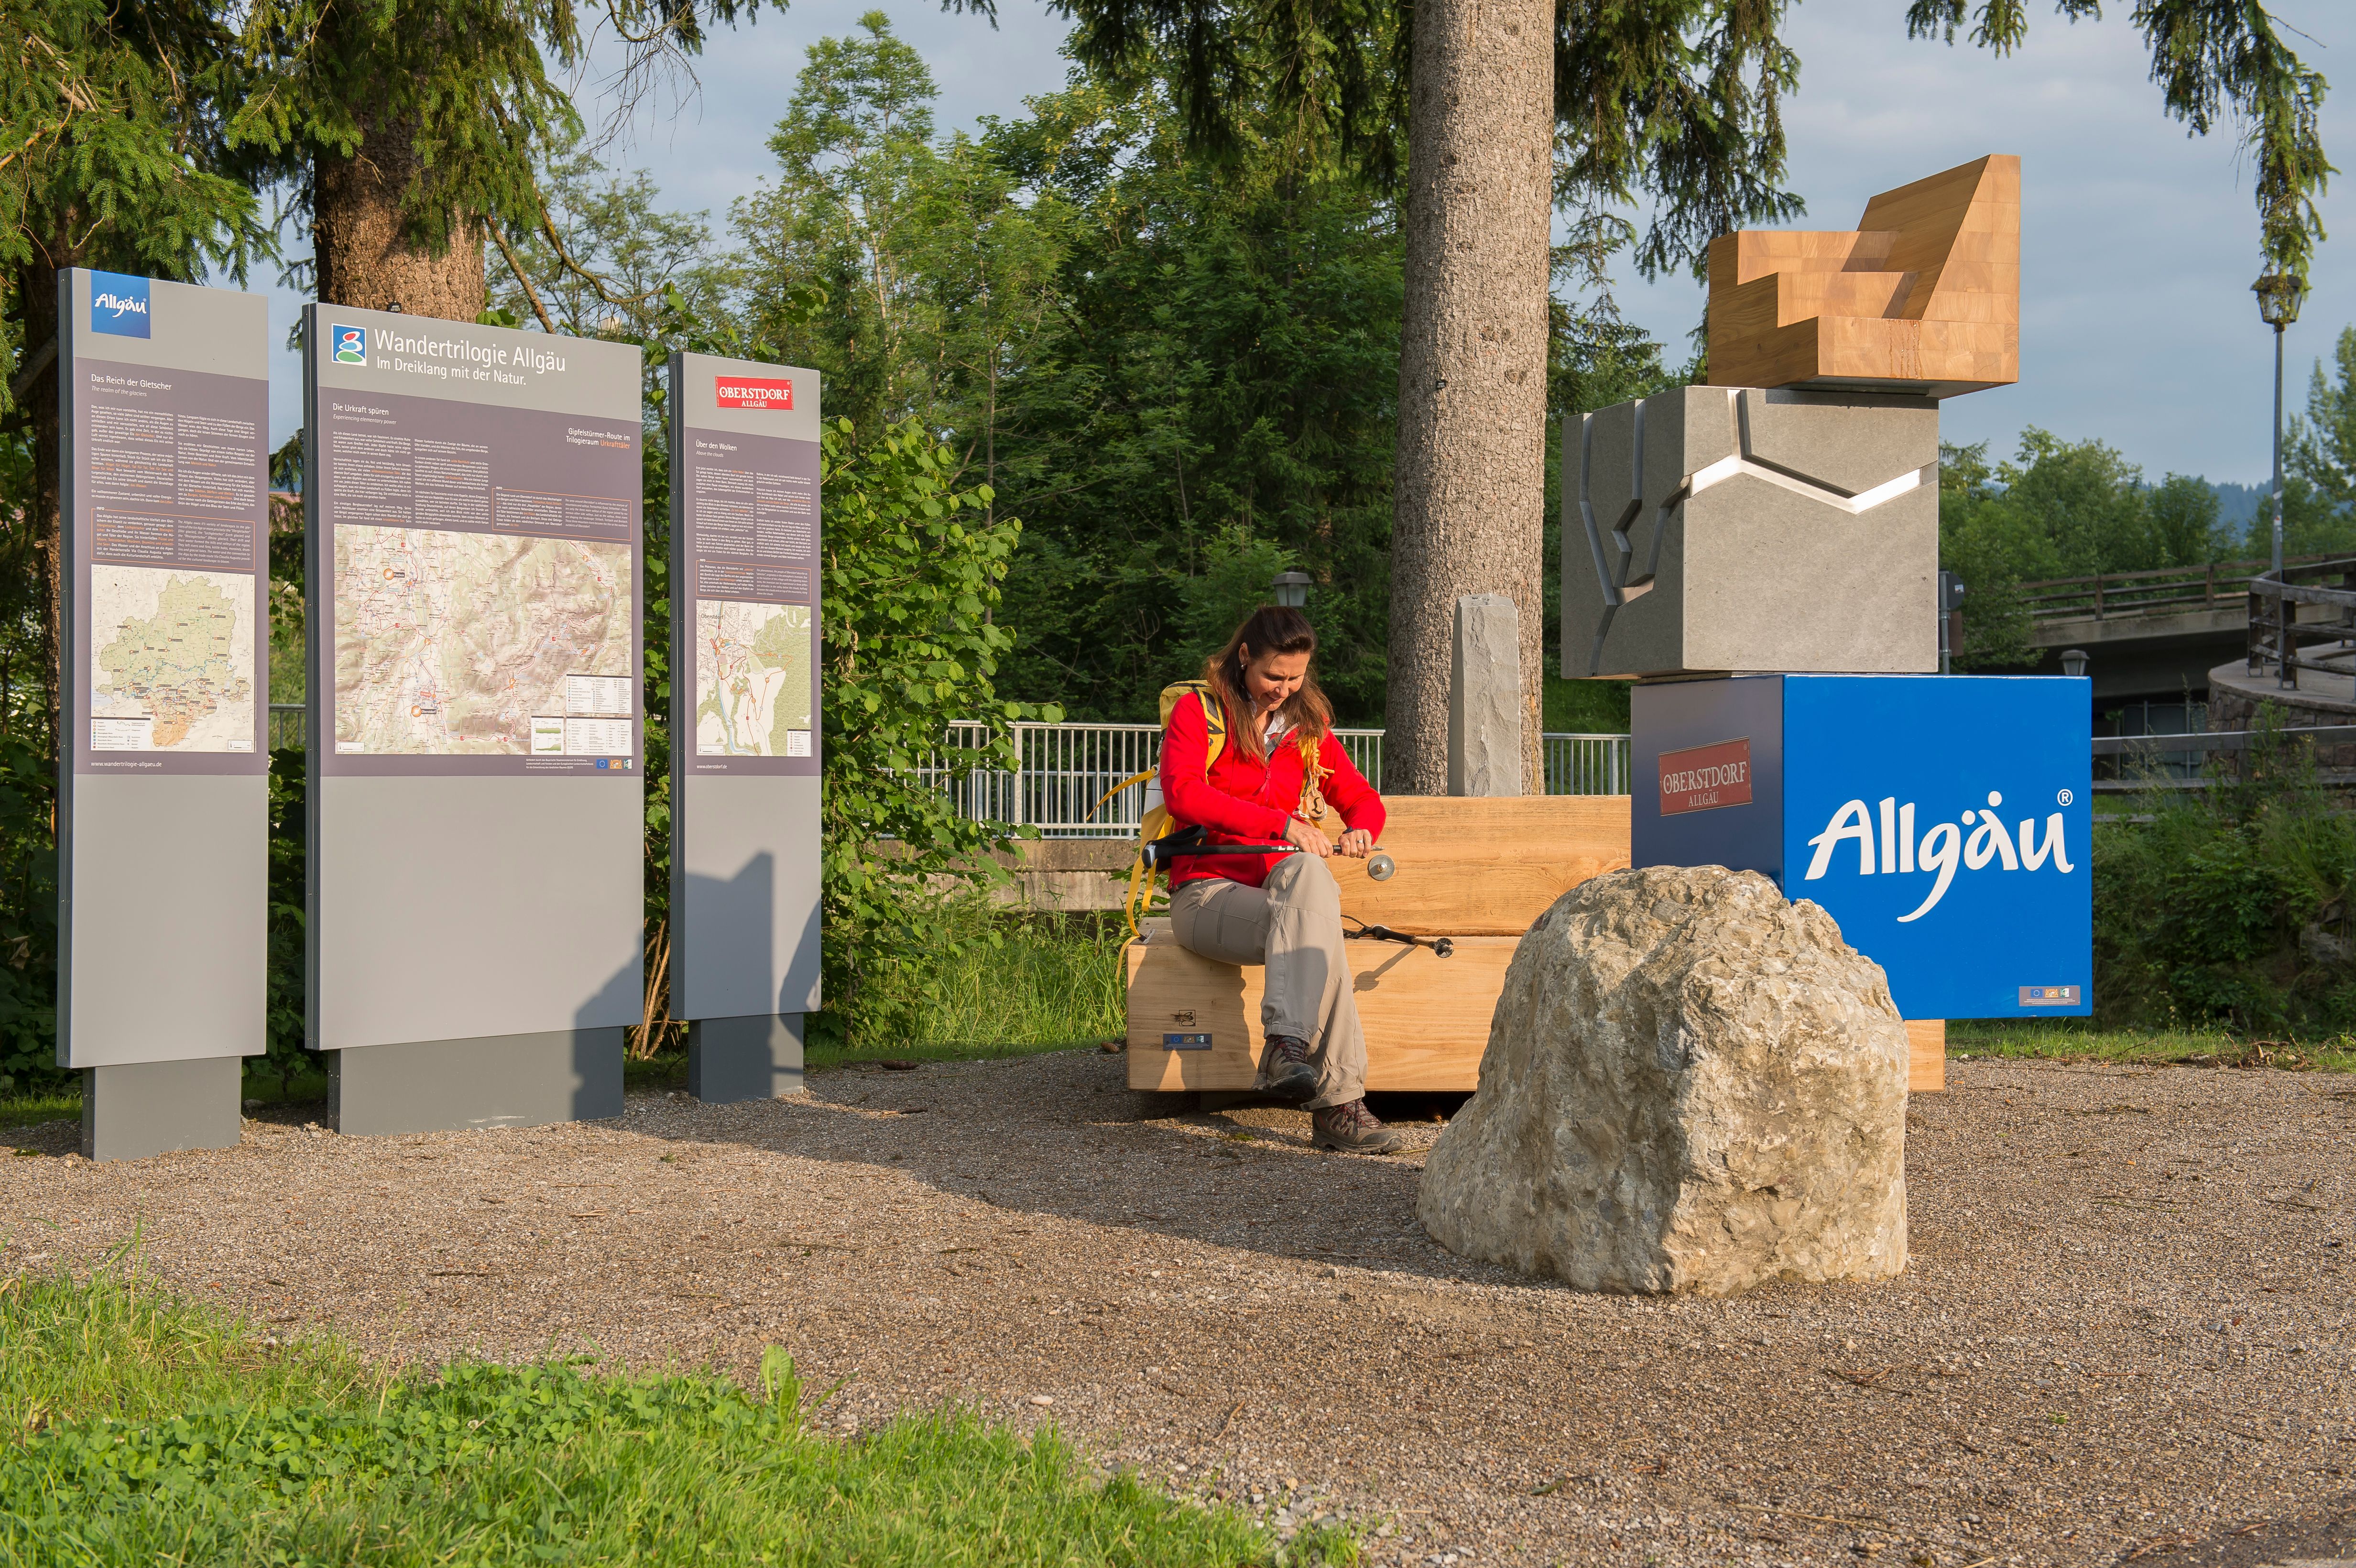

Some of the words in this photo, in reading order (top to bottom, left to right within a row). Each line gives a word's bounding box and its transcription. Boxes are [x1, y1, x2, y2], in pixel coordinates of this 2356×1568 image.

[94, 293, 147, 317] Allgäu
[374, 328, 507, 368] Wandertrilogie
[512, 346, 566, 374] Allgäu
[377, 356, 390, 370] Im
[394, 358, 447, 379] Dreiklang
[451, 366, 469, 379] mit
[473, 368, 491, 381] der
[493, 370, 526, 385] Natur.
[91, 374, 104, 382] Das
[106, 375, 125, 385] Reich
[127, 378, 138, 386] der
[140, 380, 172, 390] Gletscher
[719, 386, 790, 400] OBERSTDORF
[333, 403, 343, 411] Die
[345, 404, 367, 414] Urkraft
[368, 407, 389, 415] spüren
[742, 399, 767, 407] ALLGÄU
[333, 414, 360, 422] Experiencing
[568, 427, 622, 440] Gipfelstürmer-Route
[566, 436, 599, 446] Trilogieraum
[600, 439, 631, 449] Urkrafttäler
[696, 439, 708, 448] Über
[1663, 761, 1747, 795] OBERSTDORF
[1688, 789, 1719, 807] ALLGÄU
[1804, 791, 2074, 923] Allgäu
